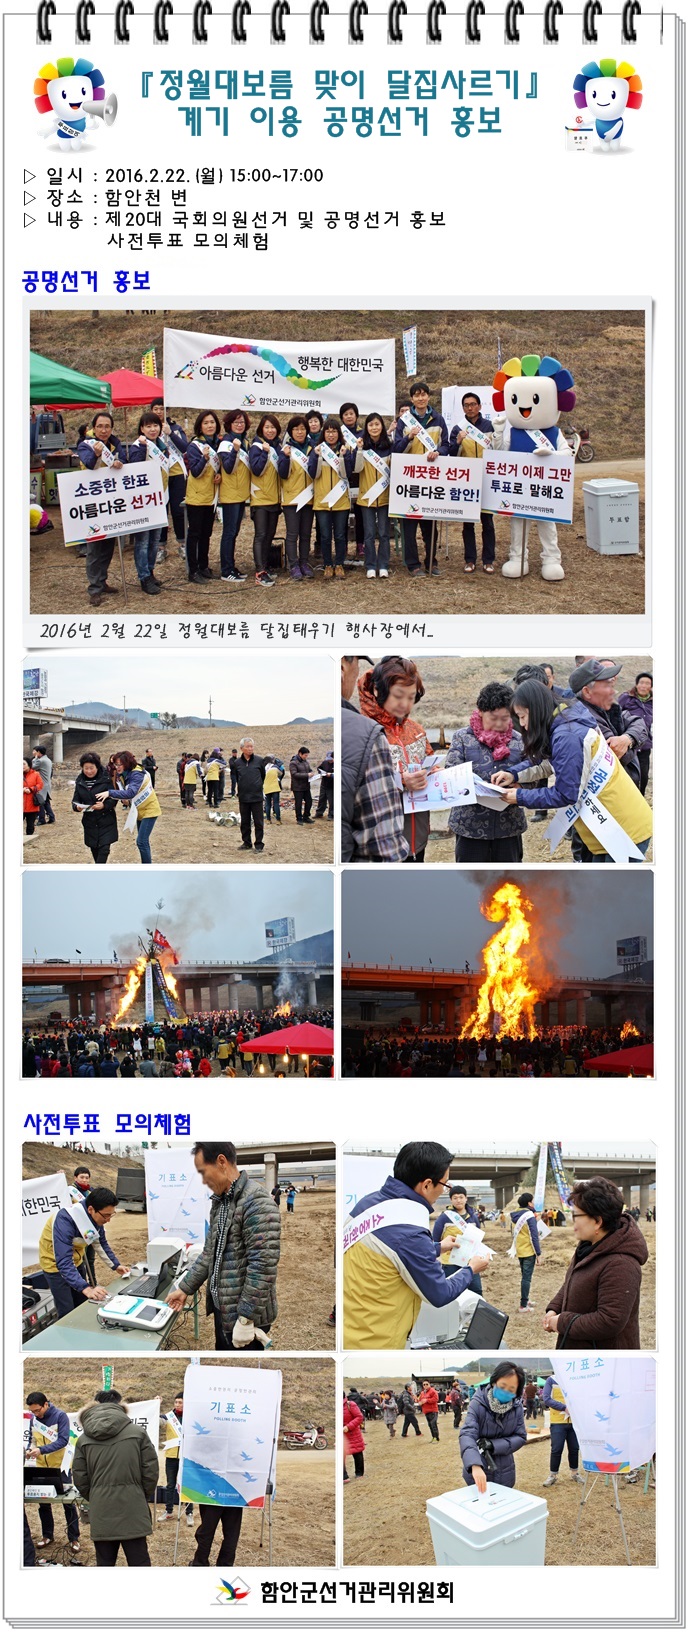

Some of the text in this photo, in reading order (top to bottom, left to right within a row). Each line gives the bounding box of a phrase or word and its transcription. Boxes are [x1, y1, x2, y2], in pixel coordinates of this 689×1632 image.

[297, 355, 384, 373] 행복한 대한민국
[199, 365, 275, 384] 아름다운 선거
[402, 464, 470, 482] 깨끗한 선거
[485, 461, 572, 483] 돈선거 이제 그만
[74, 473, 150, 498] 소중한 한표
[396, 484, 480, 503] 아름다운 함안!
[490, 479, 565, 500] 투표로 말해요
[69, 490, 164, 521] 아름다운 선거!
